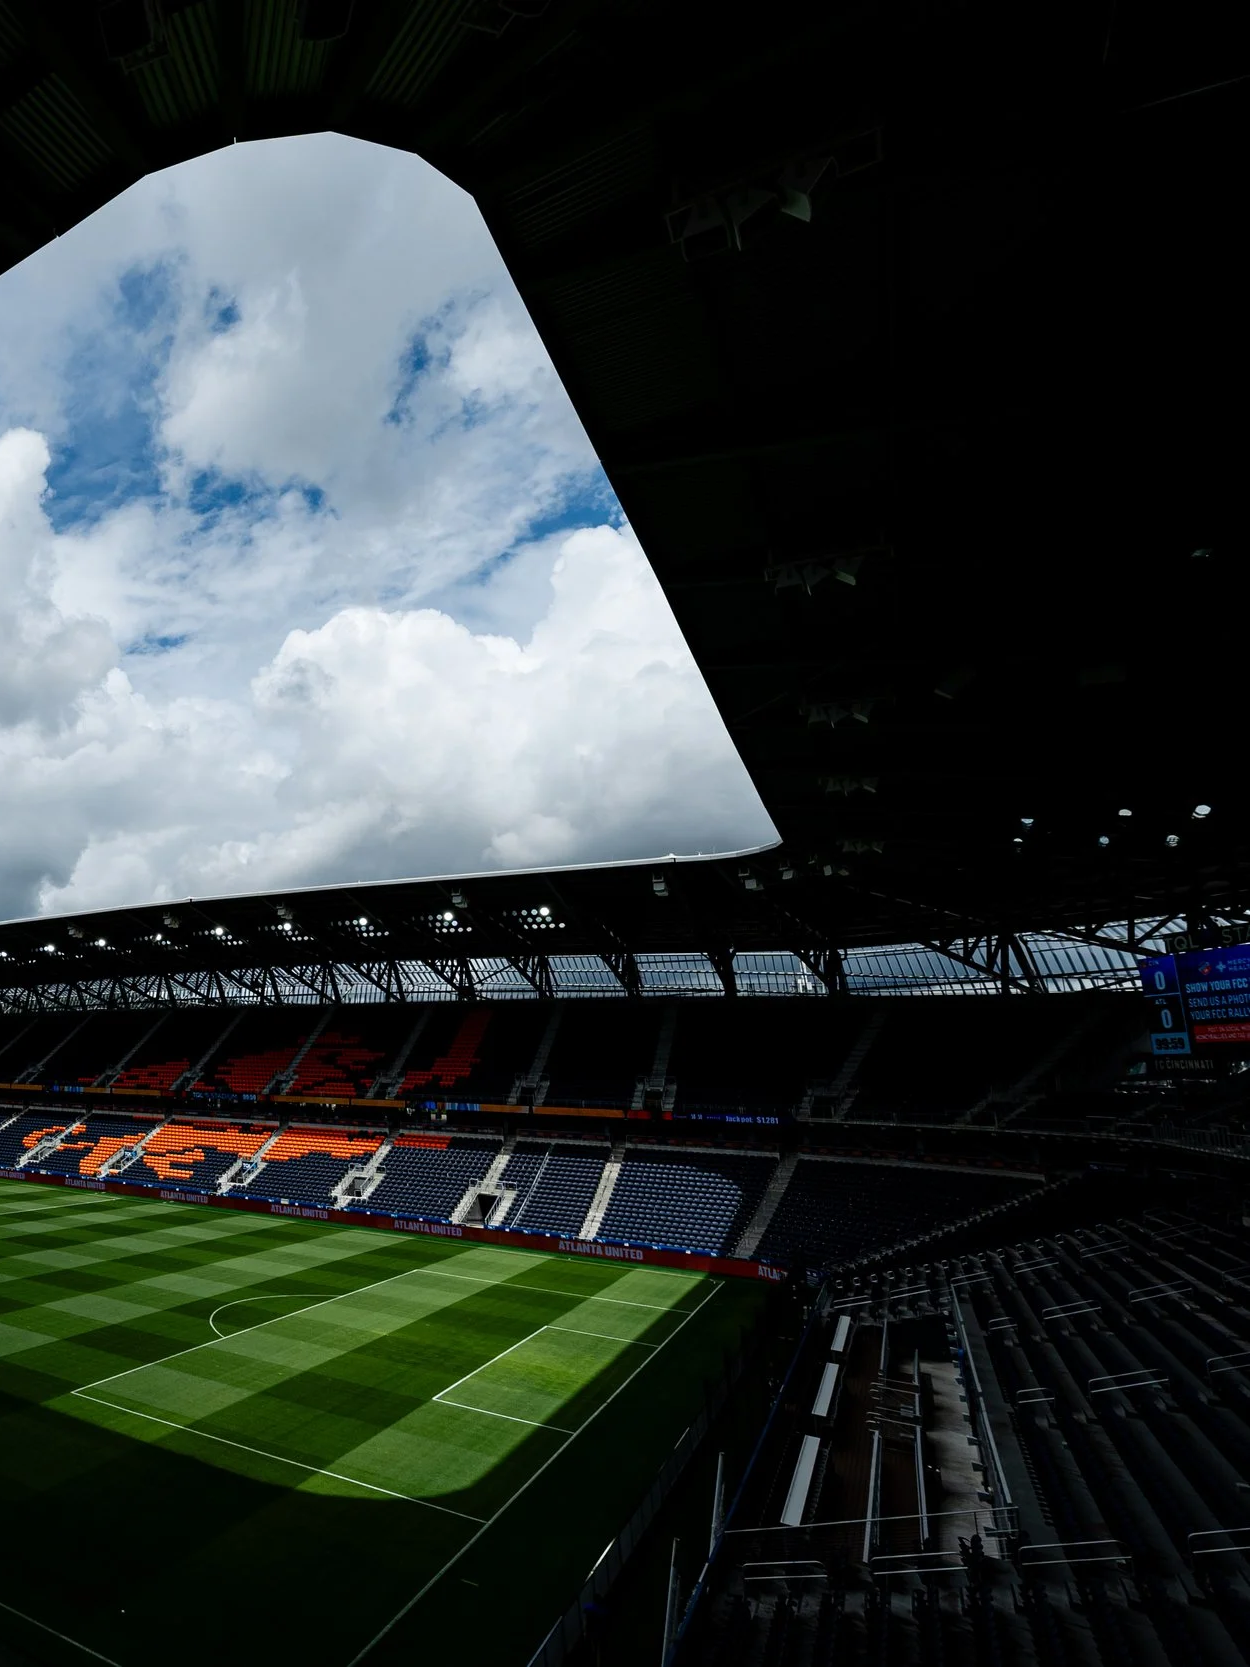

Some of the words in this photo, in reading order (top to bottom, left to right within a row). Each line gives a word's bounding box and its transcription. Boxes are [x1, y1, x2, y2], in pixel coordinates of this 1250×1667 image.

[1165, 935, 1200, 953] TQL
[1154, 971, 1166, 990] 0
[1185, 982, 1208, 993] SHOW
[1209, 980, 1231, 991] YOUR
[1232, 978, 1248, 990] FCC
[1188, 997, 1208, 1008] SEND
[1210, 996, 1220, 1006] US
[1221, 995, 1228, 1004] A
[1160, 1008, 1173, 1029] 0
[1190, 1010, 1210, 1020] YOUR
[1211, 1009, 1227, 1019] FCC
[1166, 1058, 1214, 1070] CINCINNATI
[160, 1190, 186, 1201] ATLANTA
[186, 1193, 209, 1203] UNITED
[270, 1204, 300, 1215] ATLANTA
[302, 1207, 328, 1219] UNITED
[394, 1220, 430, 1233] ATLANTA
[431, 1224, 462, 1237] UNITED
[558, 1240, 602, 1255] ATLANTA
[605, 1247, 643, 1260] UNITED
